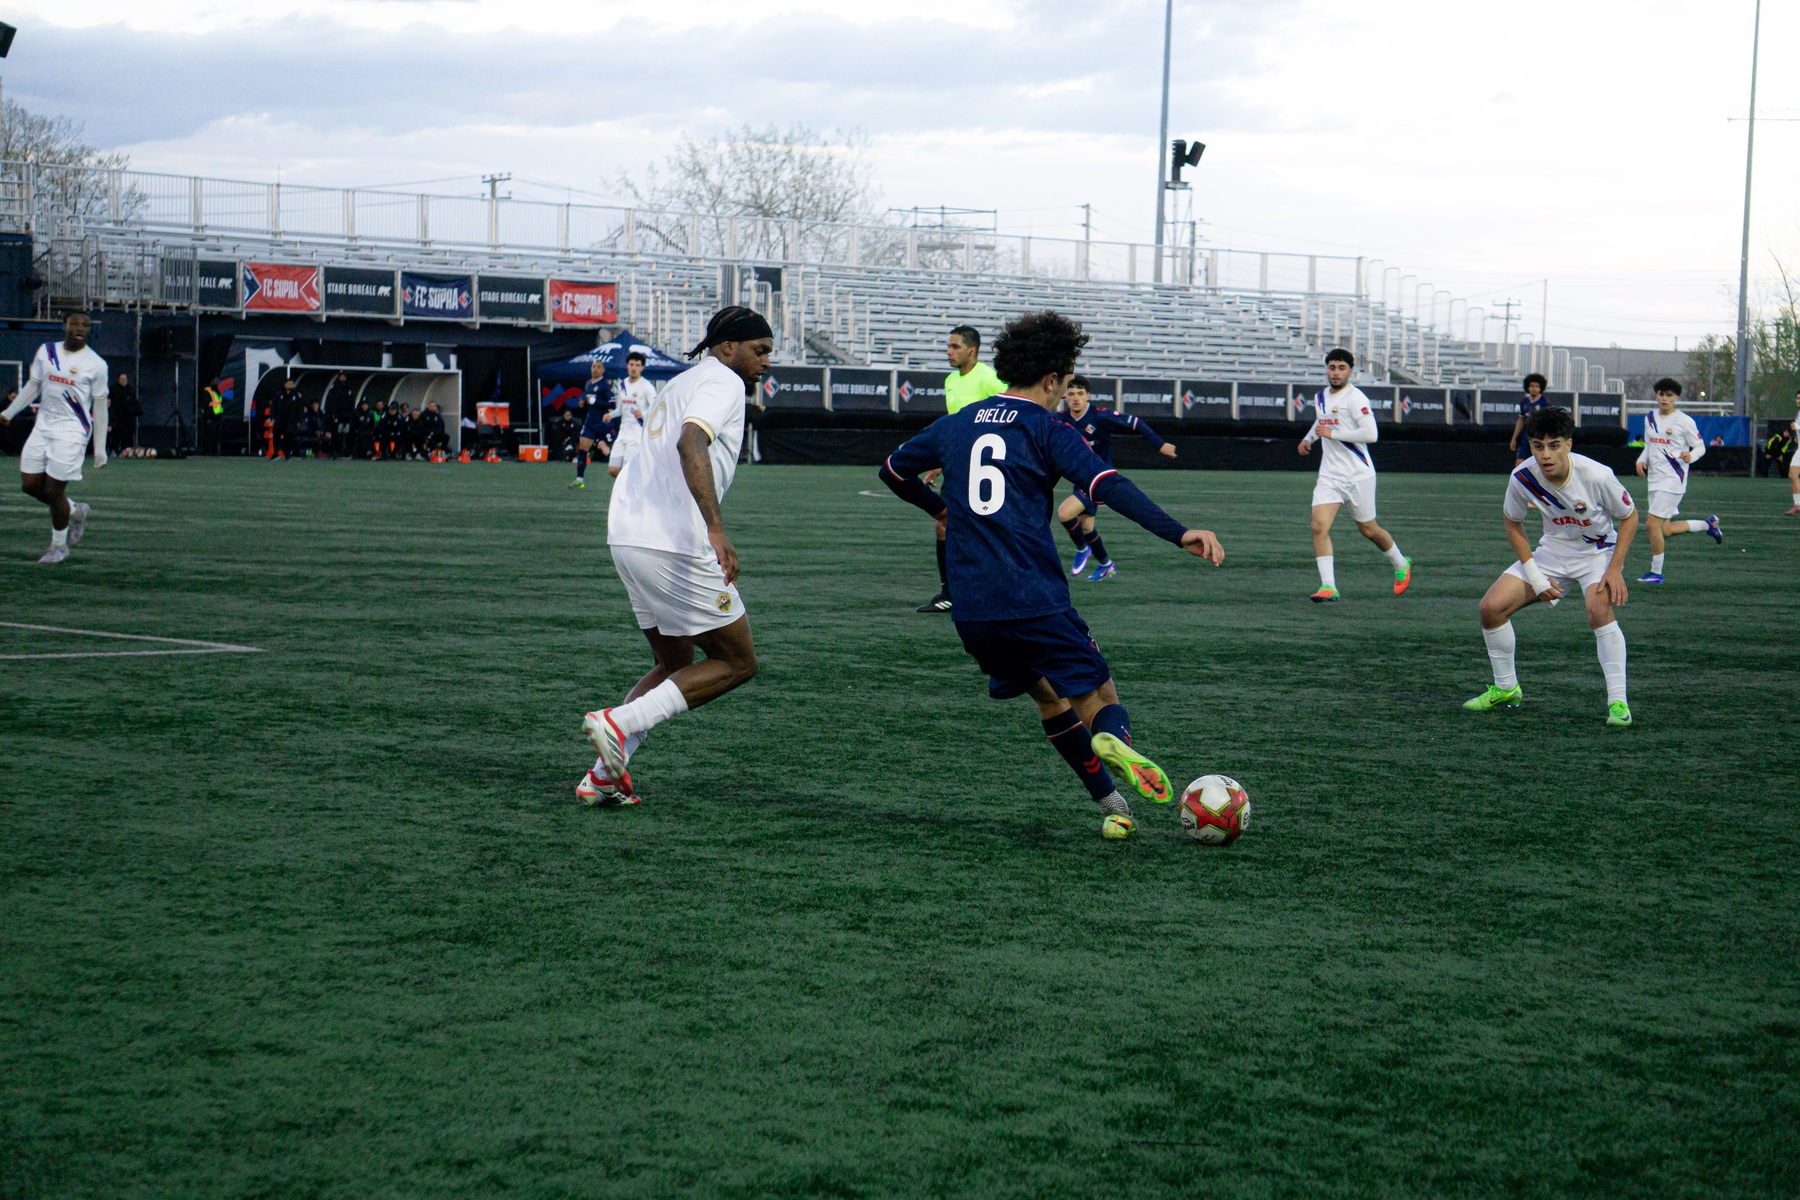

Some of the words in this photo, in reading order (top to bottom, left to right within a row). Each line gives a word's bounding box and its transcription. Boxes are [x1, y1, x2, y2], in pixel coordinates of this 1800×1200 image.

[262, 278, 272, 297] FC
[273, 279, 299, 299] SUPRA
[327, 282, 347, 295] STADE
[415, 285, 427, 308] FC
[428, 287, 459, 310] SUPRA
[480, 291, 500, 303] STADE
[561, 292, 573, 314] FC
[574, 294, 603, 316] SUPRA
[793, 384, 821, 392] SUPRA
[914, 388, 925, 396] FC
[927, 388, 946, 396] SUPR
[974, 408, 1018, 423] BIELLO
[968, 433, 1007, 516] 6
